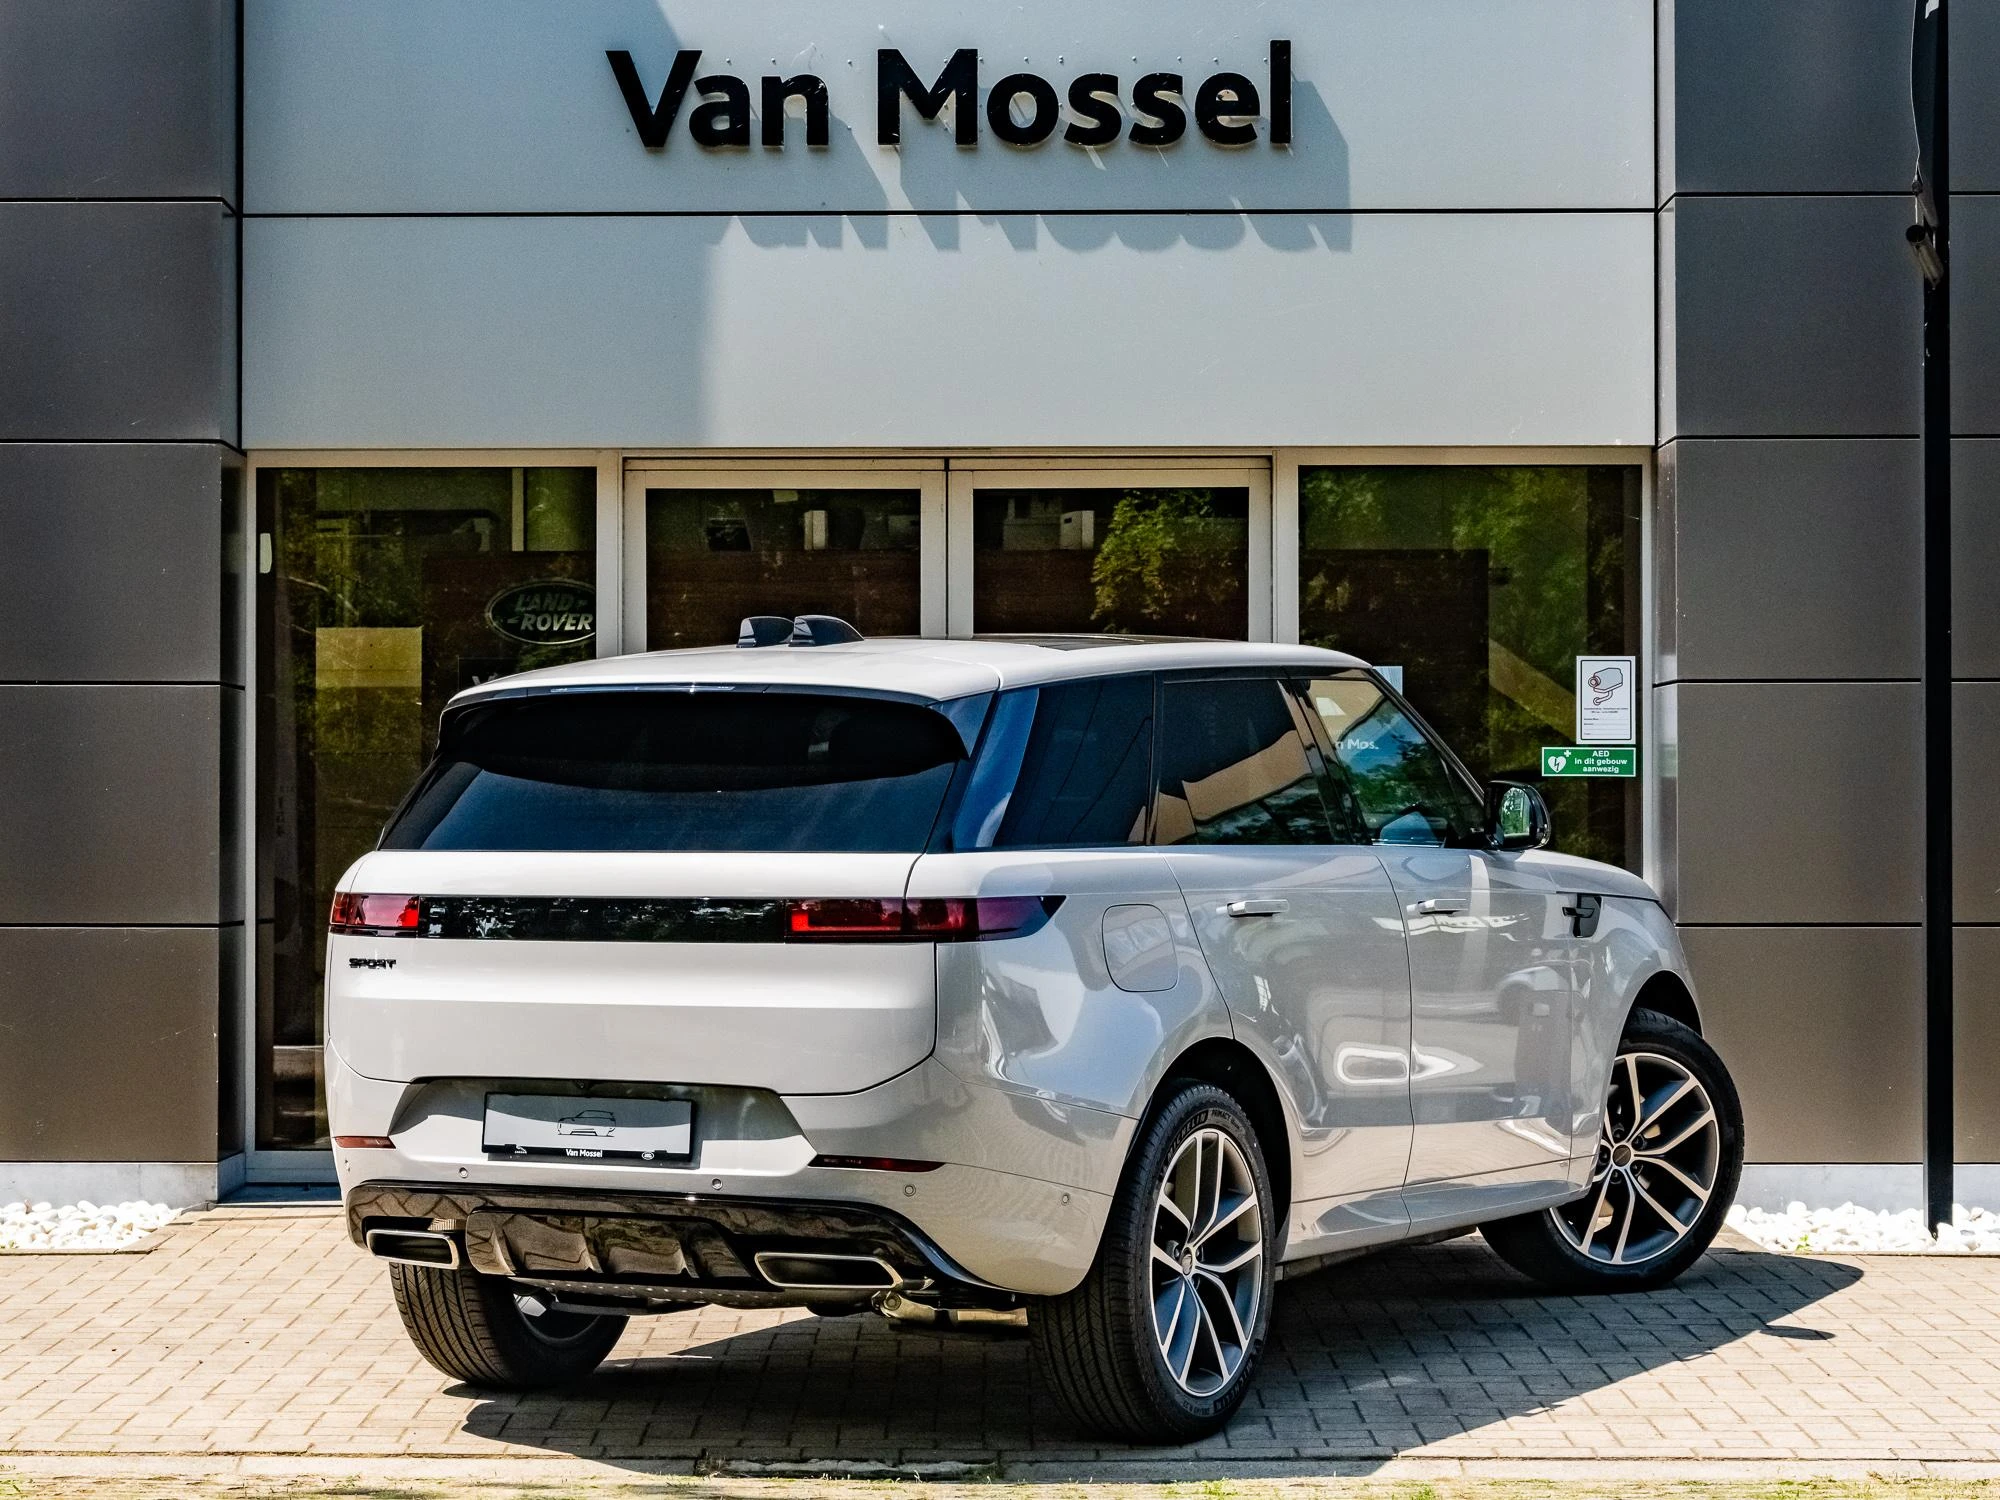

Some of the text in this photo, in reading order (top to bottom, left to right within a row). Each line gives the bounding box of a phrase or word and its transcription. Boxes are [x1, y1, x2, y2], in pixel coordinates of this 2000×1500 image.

[605, 40, 1291, 147] Van Mossel
[515, 593, 574, 612] LAND
[520, 613, 594, 631] ROVER
[1596, 758, 1628, 766] gebouw
[1582, 766, 1620, 774] aanwezig
[349, 958, 397, 970] SPORT
[1167, 1111, 1207, 1164] MICHELIN
[565, 1148, 603, 1158] Van Mossel
